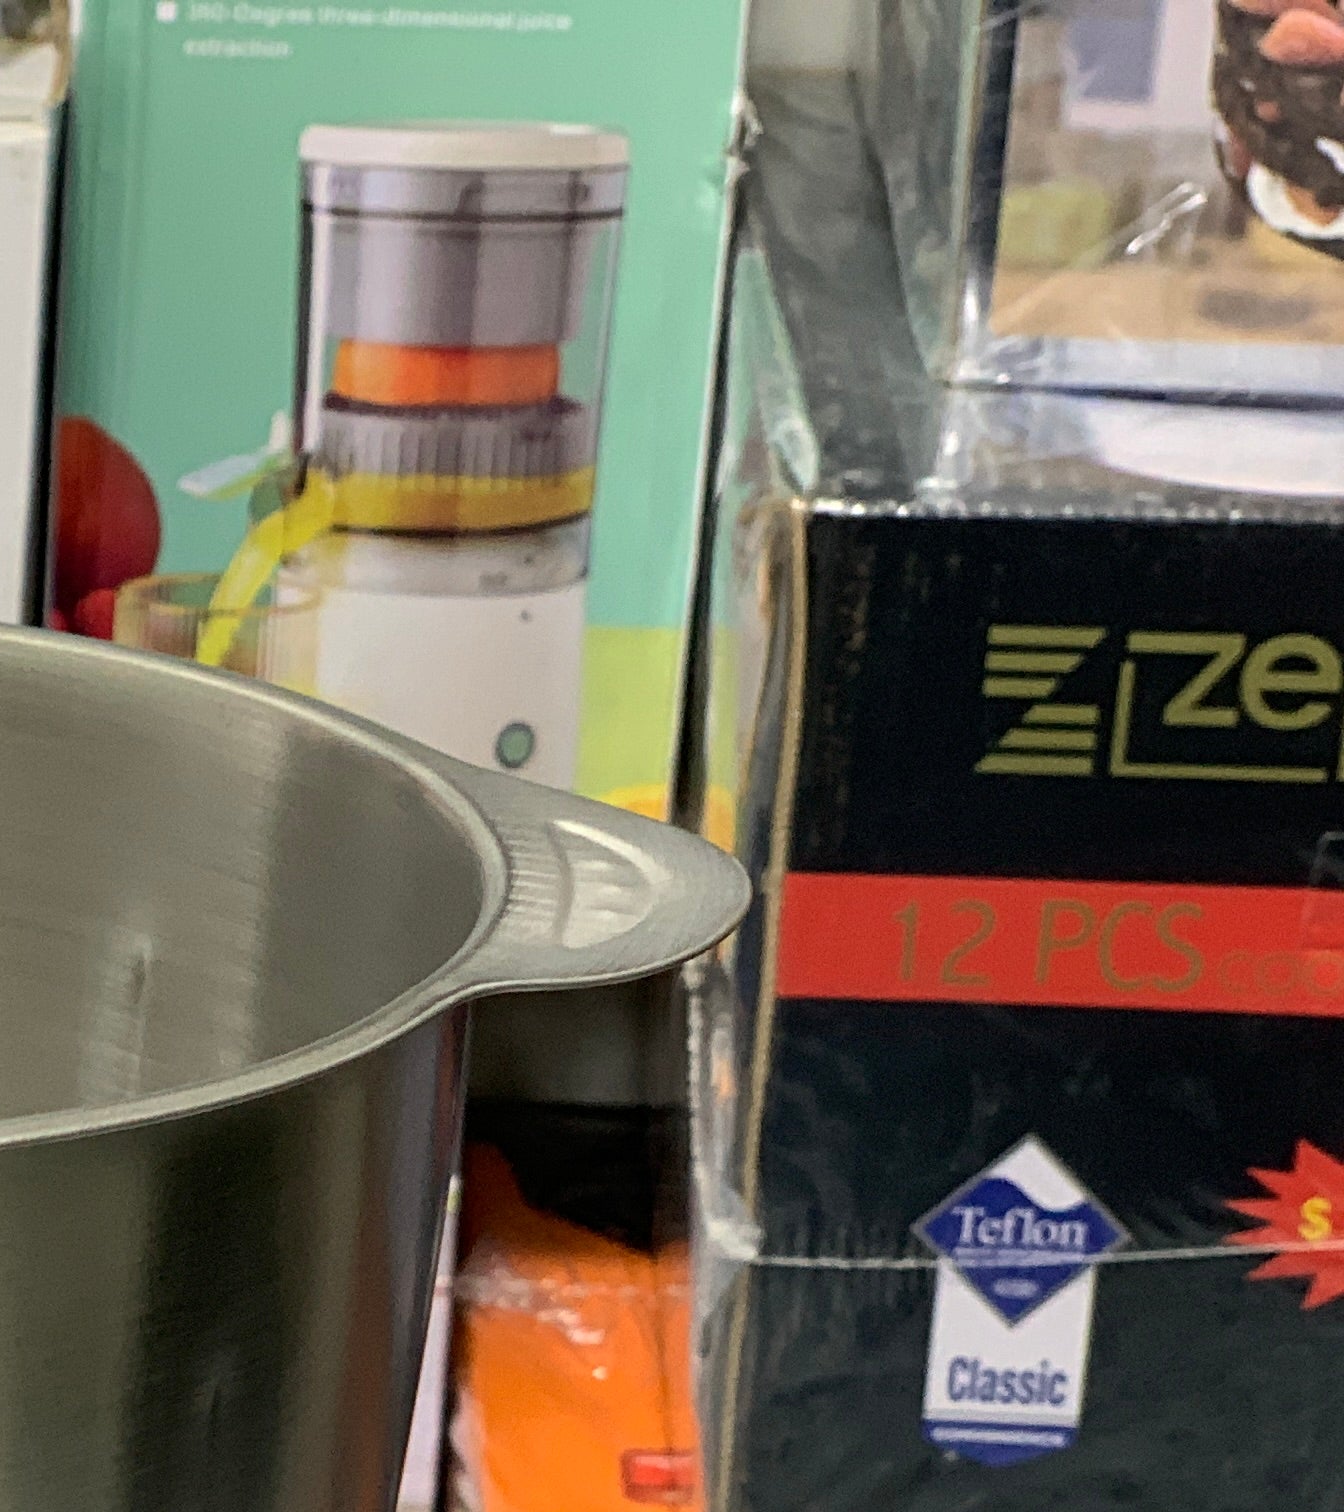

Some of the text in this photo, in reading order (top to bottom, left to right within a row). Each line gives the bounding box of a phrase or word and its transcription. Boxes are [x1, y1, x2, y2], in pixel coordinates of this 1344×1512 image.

[892, 898, 997, 987] 12
[1034, 898, 1206, 994] PCS
[953, 1205, 1086, 1248] Teflon
[947, 1356, 1069, 1406] Classic
